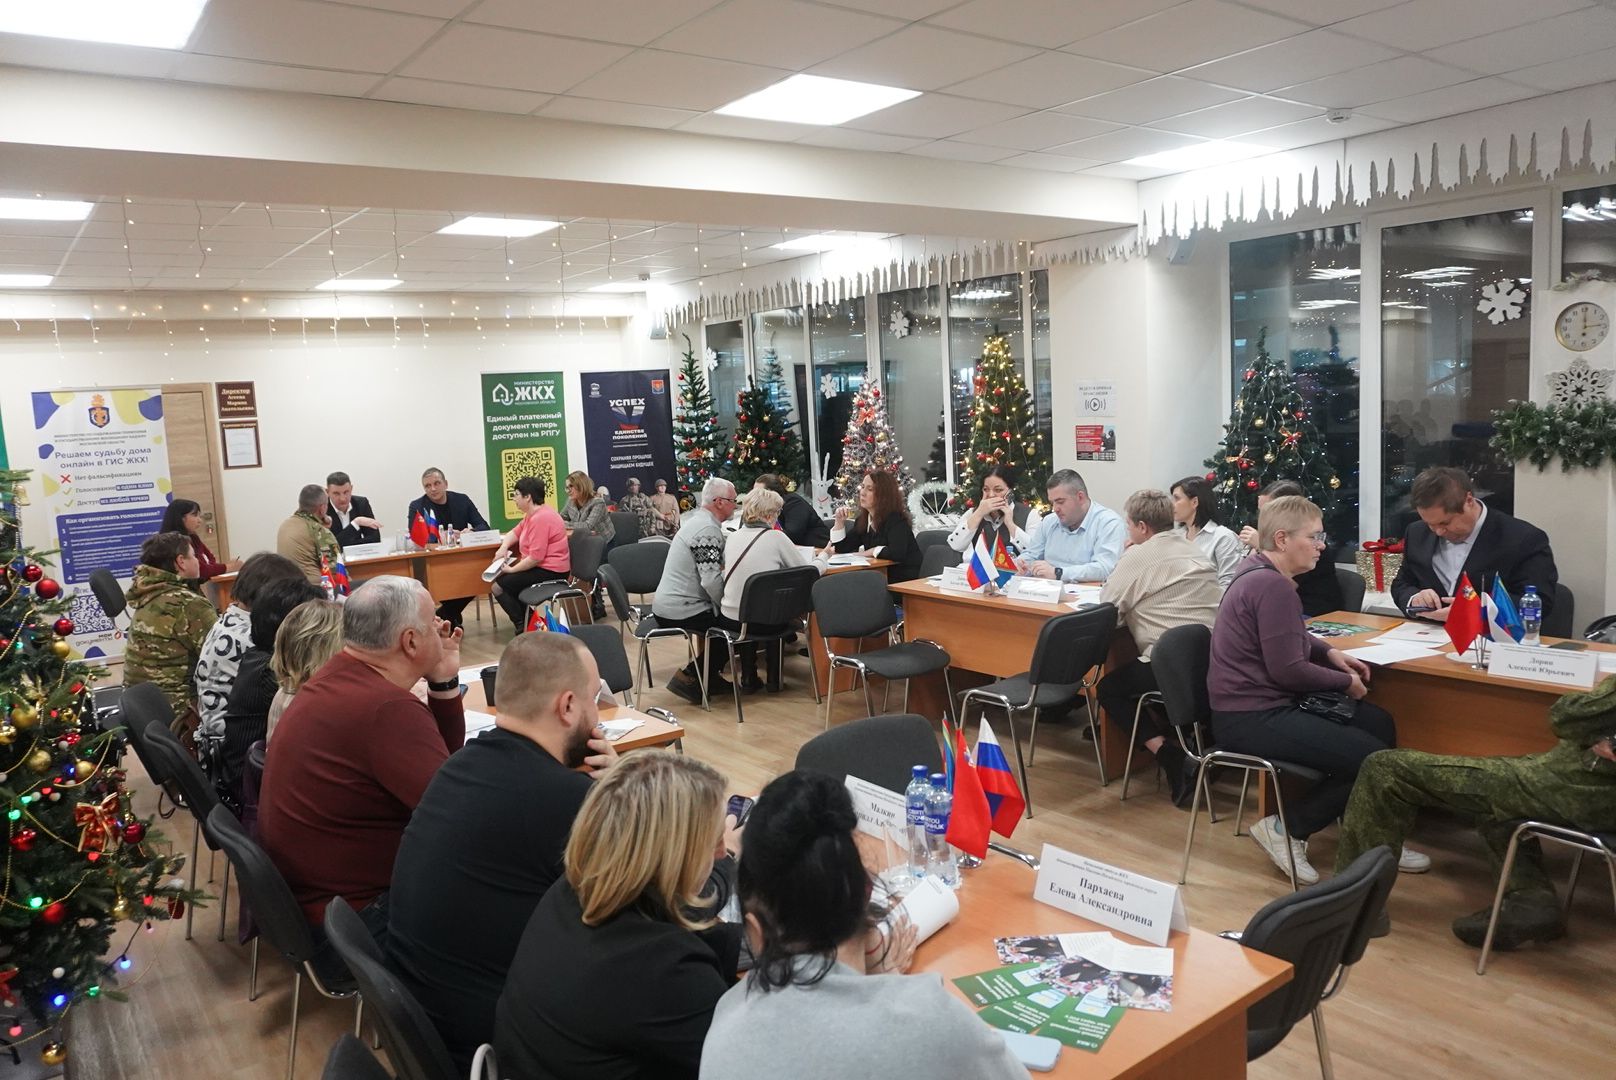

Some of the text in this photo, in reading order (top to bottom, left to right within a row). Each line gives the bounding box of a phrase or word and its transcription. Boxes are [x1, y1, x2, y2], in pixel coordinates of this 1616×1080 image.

[514, 386, 555, 401] ЖКХ
[609, 398, 645, 407] УСПЕХ
[487, 412, 562, 423] Единый платежный
[493, 424, 530, 432] документ
[492, 432, 529, 441] доступен
[55, 447, 151, 459] Решаем судьбу дома
[60, 460, 95, 469] онлайн
[105, 458, 124, 466] ГИС
[126, 456, 149, 464] ЖКХ!
[1507, 663, 1575, 677] Алексей Юрьевич
[1080, 877, 1124, 902] Пархаева
[1050, 882, 1153, 928] Елена Александровна
